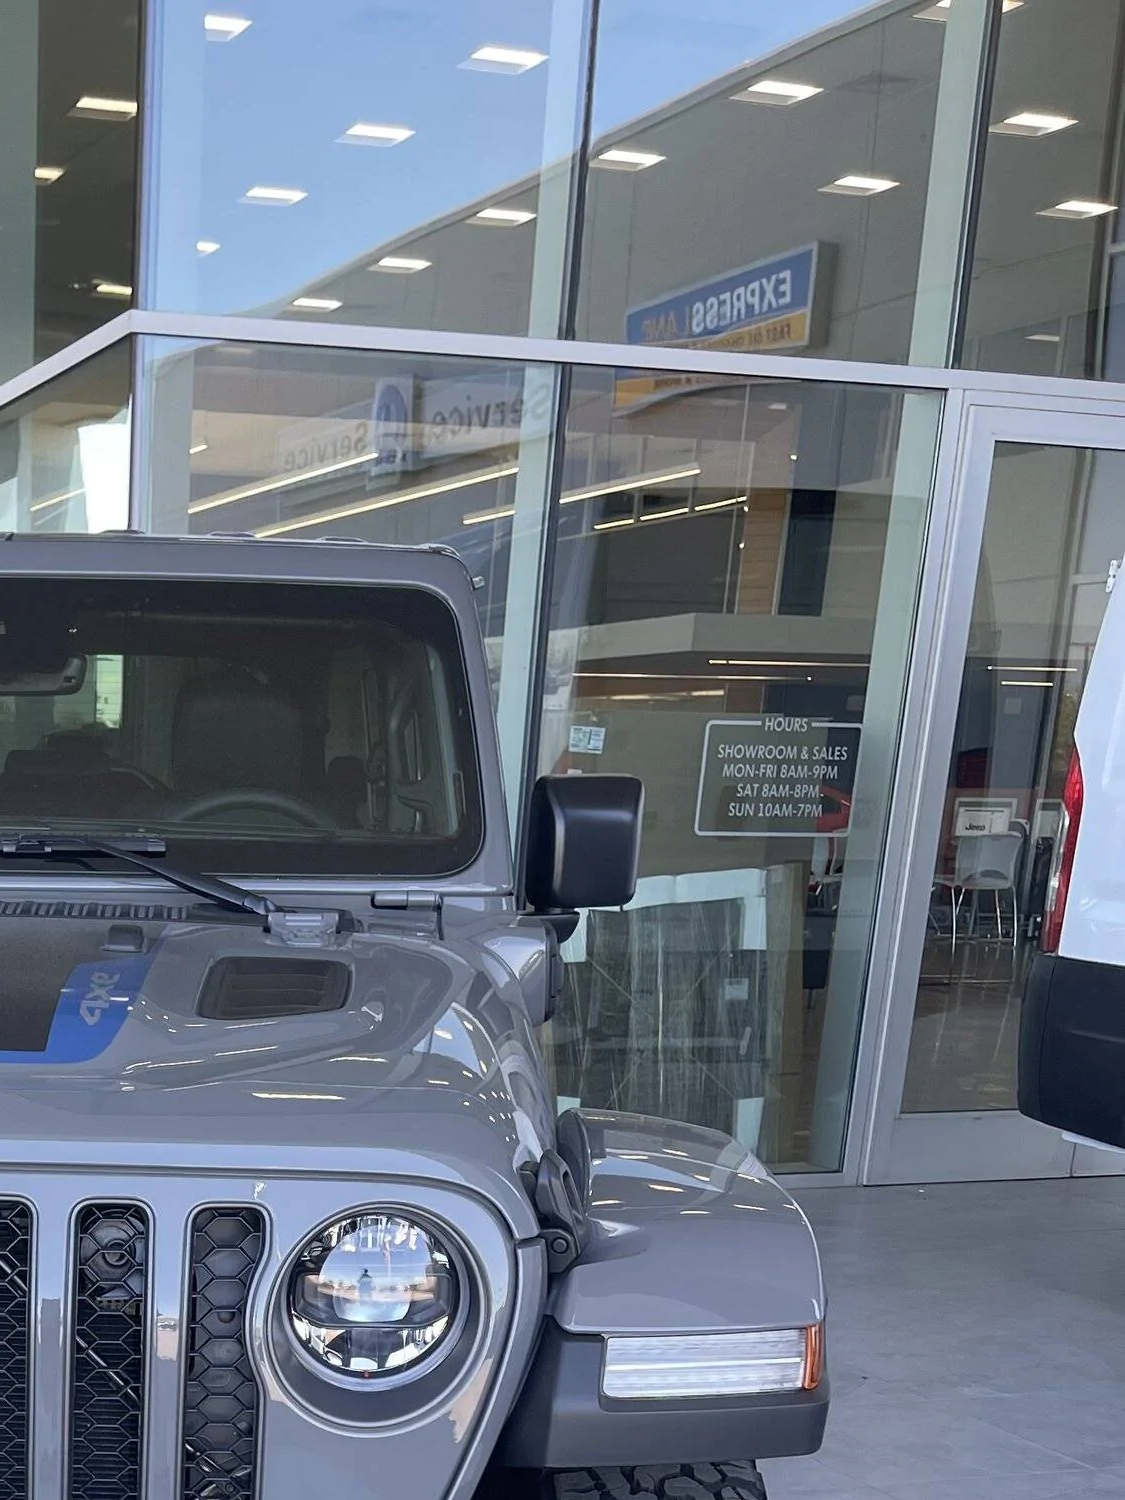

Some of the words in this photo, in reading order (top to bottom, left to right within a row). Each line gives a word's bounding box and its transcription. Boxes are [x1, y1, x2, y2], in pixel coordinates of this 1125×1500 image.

[764, 717, 808, 732] HOURS
[717, 744, 797, 760] SHOWROOM
[800, 747, 809, 760] &
[812, 747, 848, 761] SALES
[722, 763, 777, 778] MON-FRI
[780, 765, 838, 779] 8AM-9PM
[736, 783, 759, 797] SAT
[761, 784, 820, 798] 8AM-8PM
[728, 803, 755, 817] SUN
[758, 803, 823, 817] 10AM-7PM
